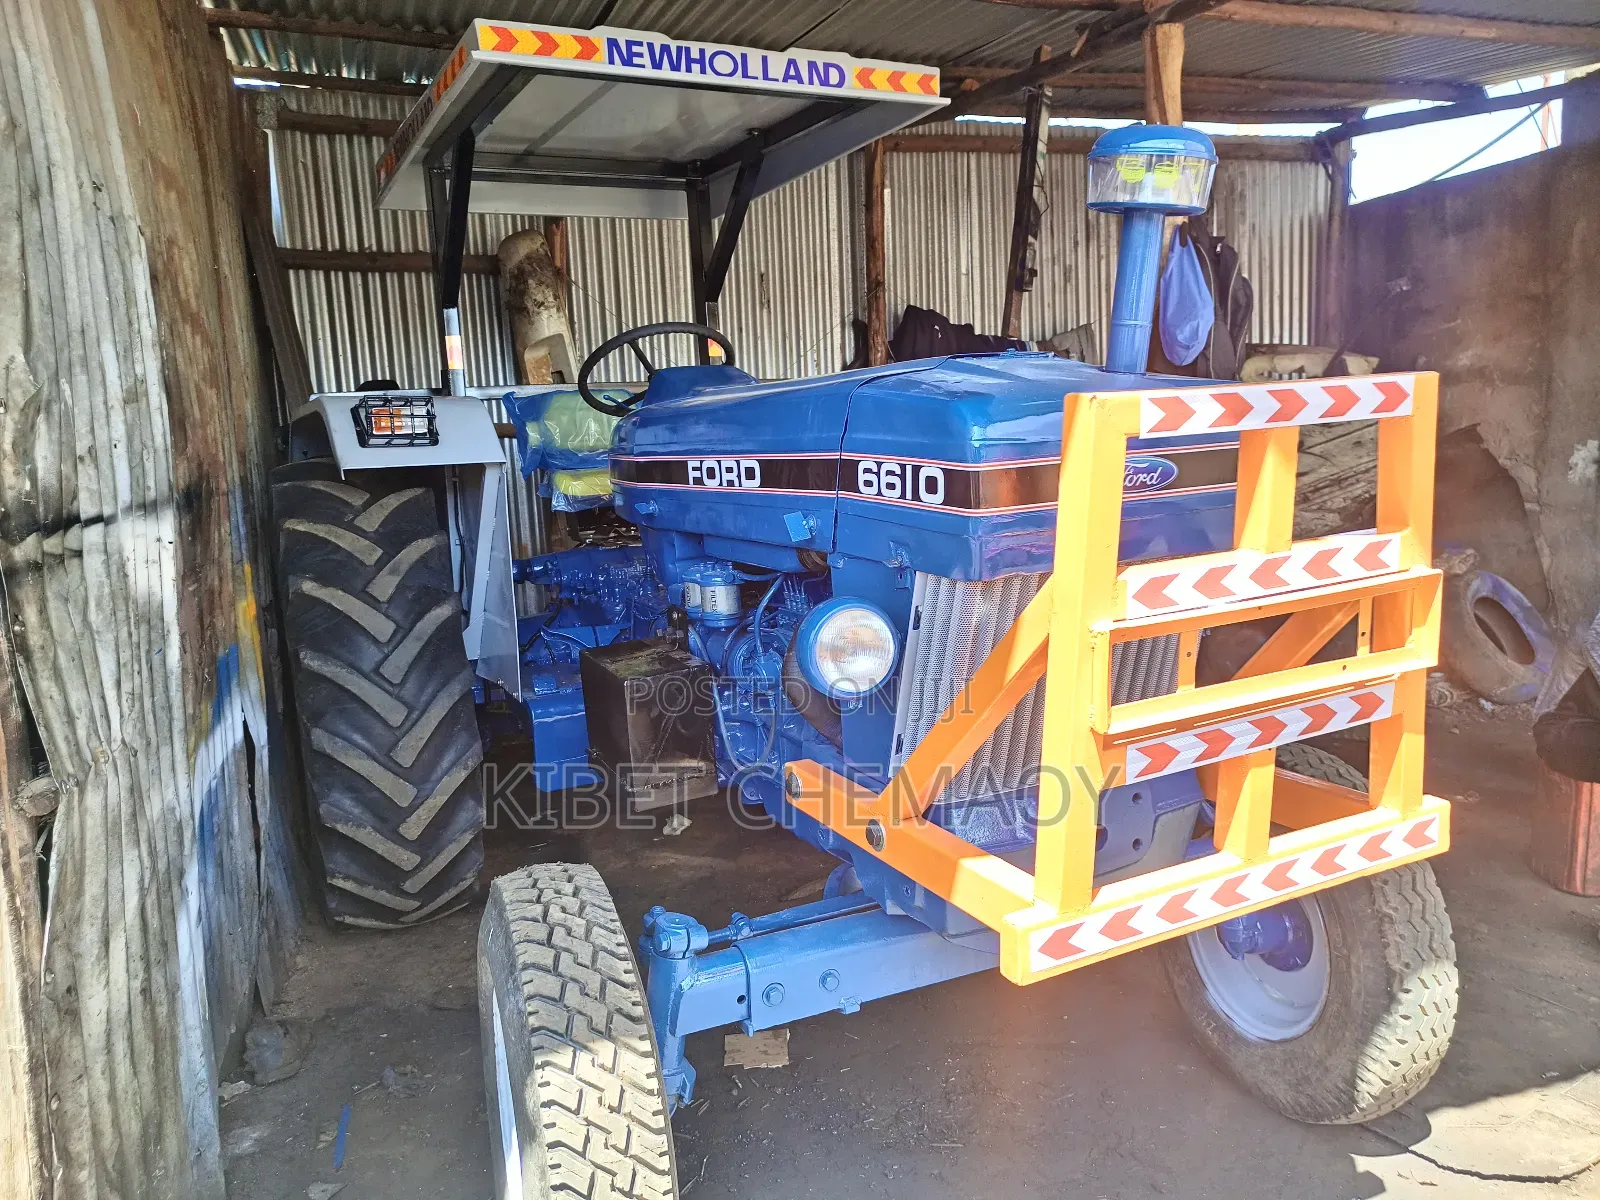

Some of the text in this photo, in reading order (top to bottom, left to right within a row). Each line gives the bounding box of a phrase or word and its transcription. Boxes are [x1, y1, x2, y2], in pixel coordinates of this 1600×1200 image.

[606, 36, 846, 88] NEWHOLLAND
[687, 460, 761, 488] FORD
[857, 461, 946, 505] 6610
[1124, 462, 1163, 486] Ford
[710, 590, 718, 613] FILTEX
